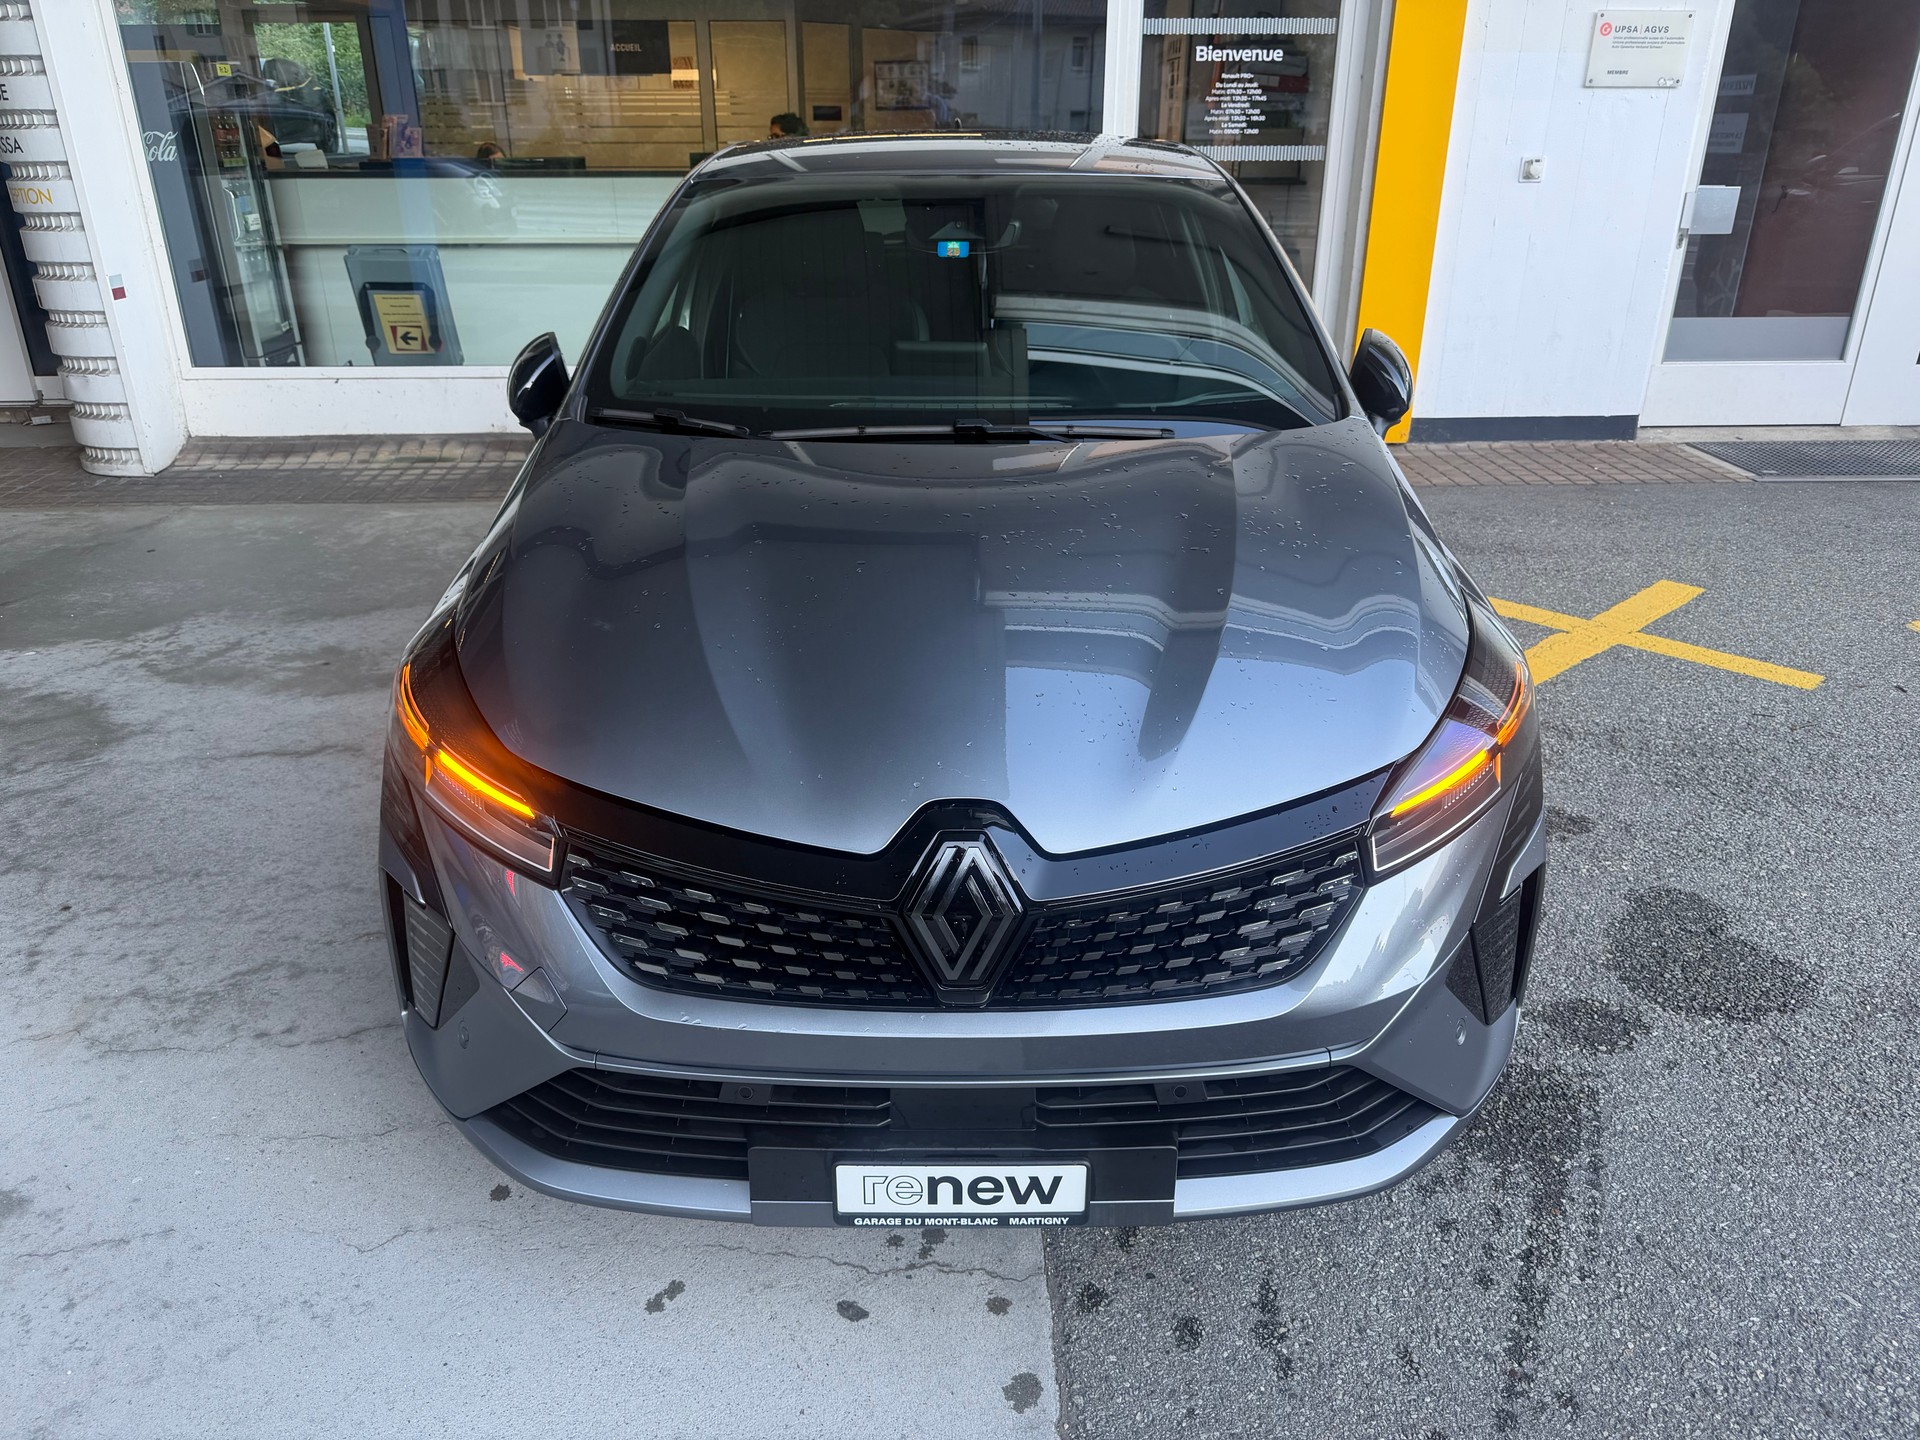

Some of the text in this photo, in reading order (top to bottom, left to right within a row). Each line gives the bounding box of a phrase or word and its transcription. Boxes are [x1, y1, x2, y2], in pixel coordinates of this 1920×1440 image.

[1614, 25, 1670, 34] UPSA AGVS
[610, 43, 642, 52] ACCUEIL
[1195, 45, 1284, 62] Bienvenue
[0, 83, 9, 101] E
[0, 136, 24, 154] SSA
[862, 1175, 1063, 1205] renew
[854, 1216, 1070, 1226] GARAGE DU MONT-BLANC MARTIGNY
